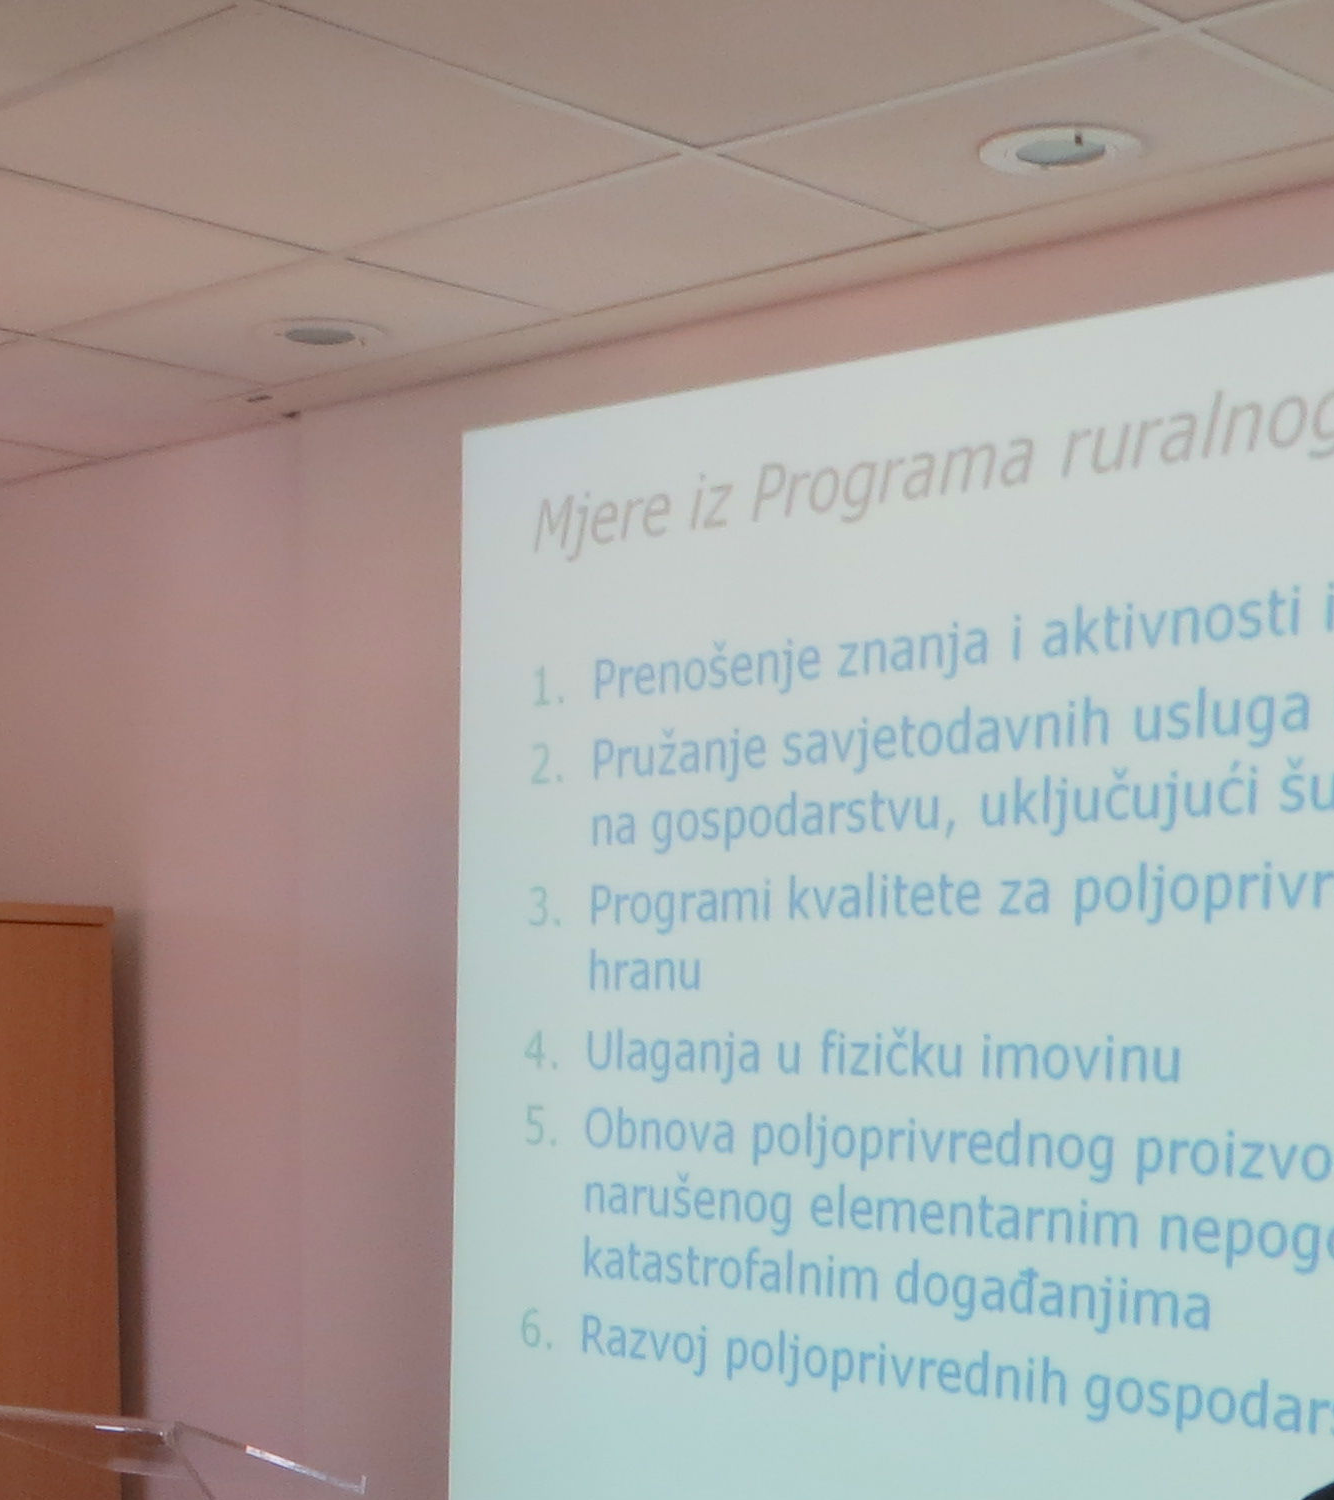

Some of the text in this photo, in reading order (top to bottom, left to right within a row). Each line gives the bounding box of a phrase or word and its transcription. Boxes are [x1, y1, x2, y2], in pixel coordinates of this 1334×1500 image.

[533, 491, 671, 562] Mjere
[689, 474, 730, 534] iz
[752, 436, 1036, 524] Programa
[533, 667, 566, 708] 1.
[594, 638, 823, 700] Prenošenje
[837, 622, 990, 679] znanja
[1011, 614, 1023, 662] i
[1042, 584, 1301, 658] aktivnosti
[531, 743, 565, 784] 2.
[593, 726, 767, 783] Pružanje
[782, 697, 1110, 772] savjetodavnih
[1134, 686, 1311, 747] usluga
[590, 809, 637, 847] na
[651, 789, 958, 855] gospodarstvu,
[980, 759, 1259, 837] uključujući
[527, 886, 562, 927] 3.
[590, 878, 773, 935] Programi
[788, 871, 982, 920] kvalitete
[999, 876, 1052, 916] za
[588, 946, 702, 993] hranu
[524, 1026, 1183, 1084] 4. Ulaganja u fizičku imovinu
[524, 1105, 558, 1147] 5.
[585, 1107, 736, 1155] Obnova
[751, 1110, 1115, 1185] poljoprivrednog
[584, 1173, 792, 1236] narušenog
[809, 1182, 1138, 1249] elementarnim
[582, 1235, 1212, 1334] katastrofalnim događanjima
[520, 1309, 553, 1350] 6.
[580, 1313, 708, 1377] Razvoj
[725, 1327, 1068, 1409] poljoprivrednih
